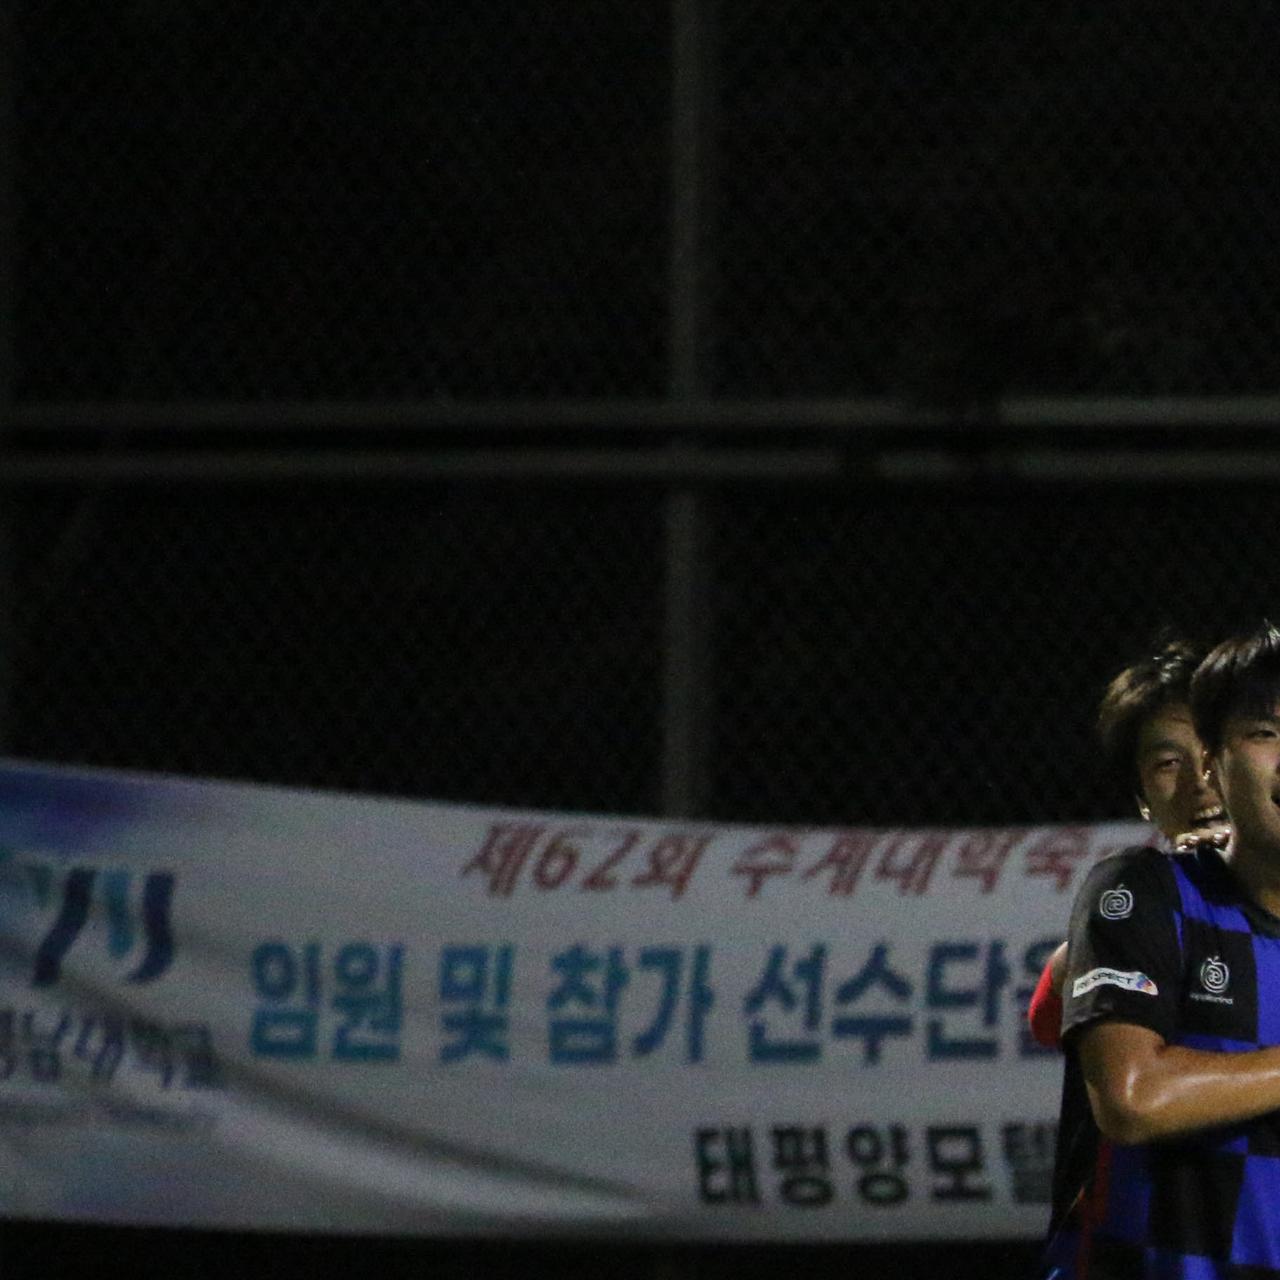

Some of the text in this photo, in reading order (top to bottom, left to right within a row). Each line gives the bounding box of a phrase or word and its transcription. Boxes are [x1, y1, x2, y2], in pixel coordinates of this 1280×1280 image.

[460, 821, 718, 900] 제62회
[250, 940, 406, 1063] 임원
[438, 942, 518, 1065] 및
[545, 940, 714, 1066] 참가
